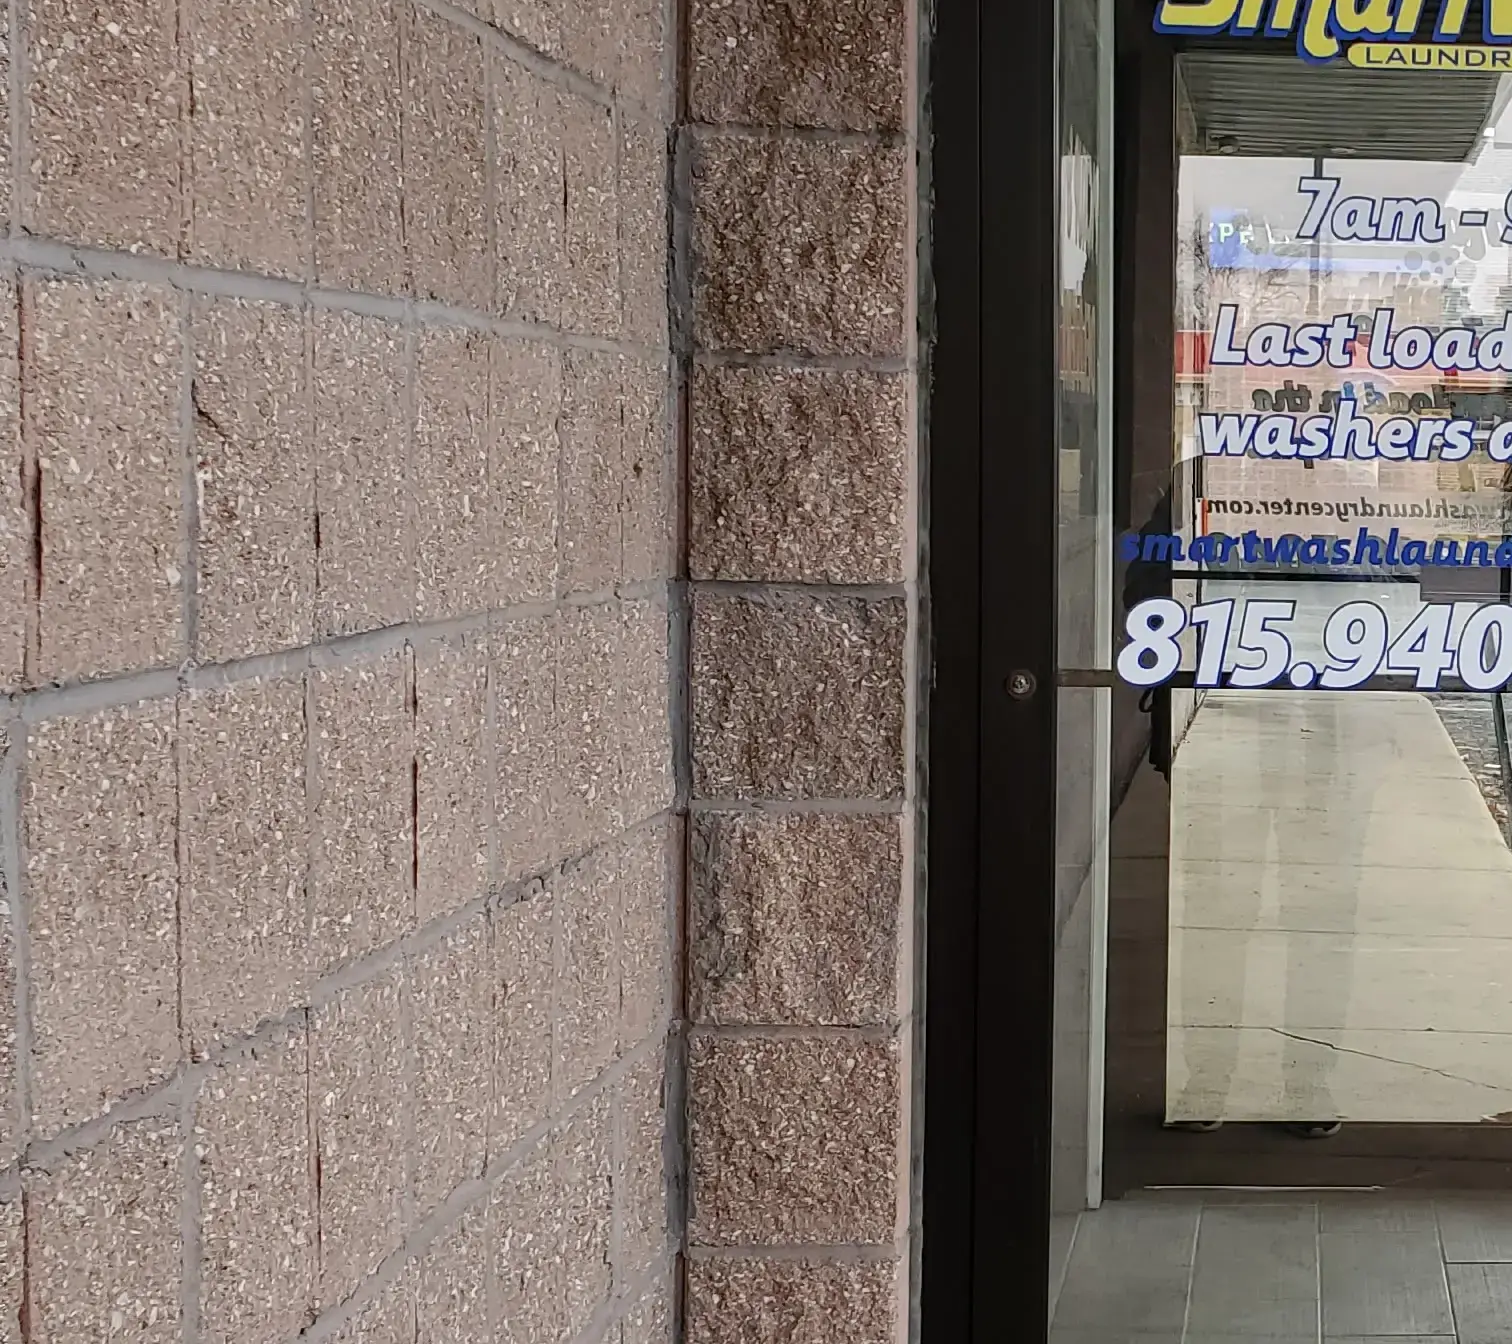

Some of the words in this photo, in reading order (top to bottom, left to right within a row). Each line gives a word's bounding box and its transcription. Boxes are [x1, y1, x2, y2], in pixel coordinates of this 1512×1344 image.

[1296, 176, 1446, 244] 7am
[1209, 304, 1356, 370] Last
[1199, 396, 1478, 464] washers
